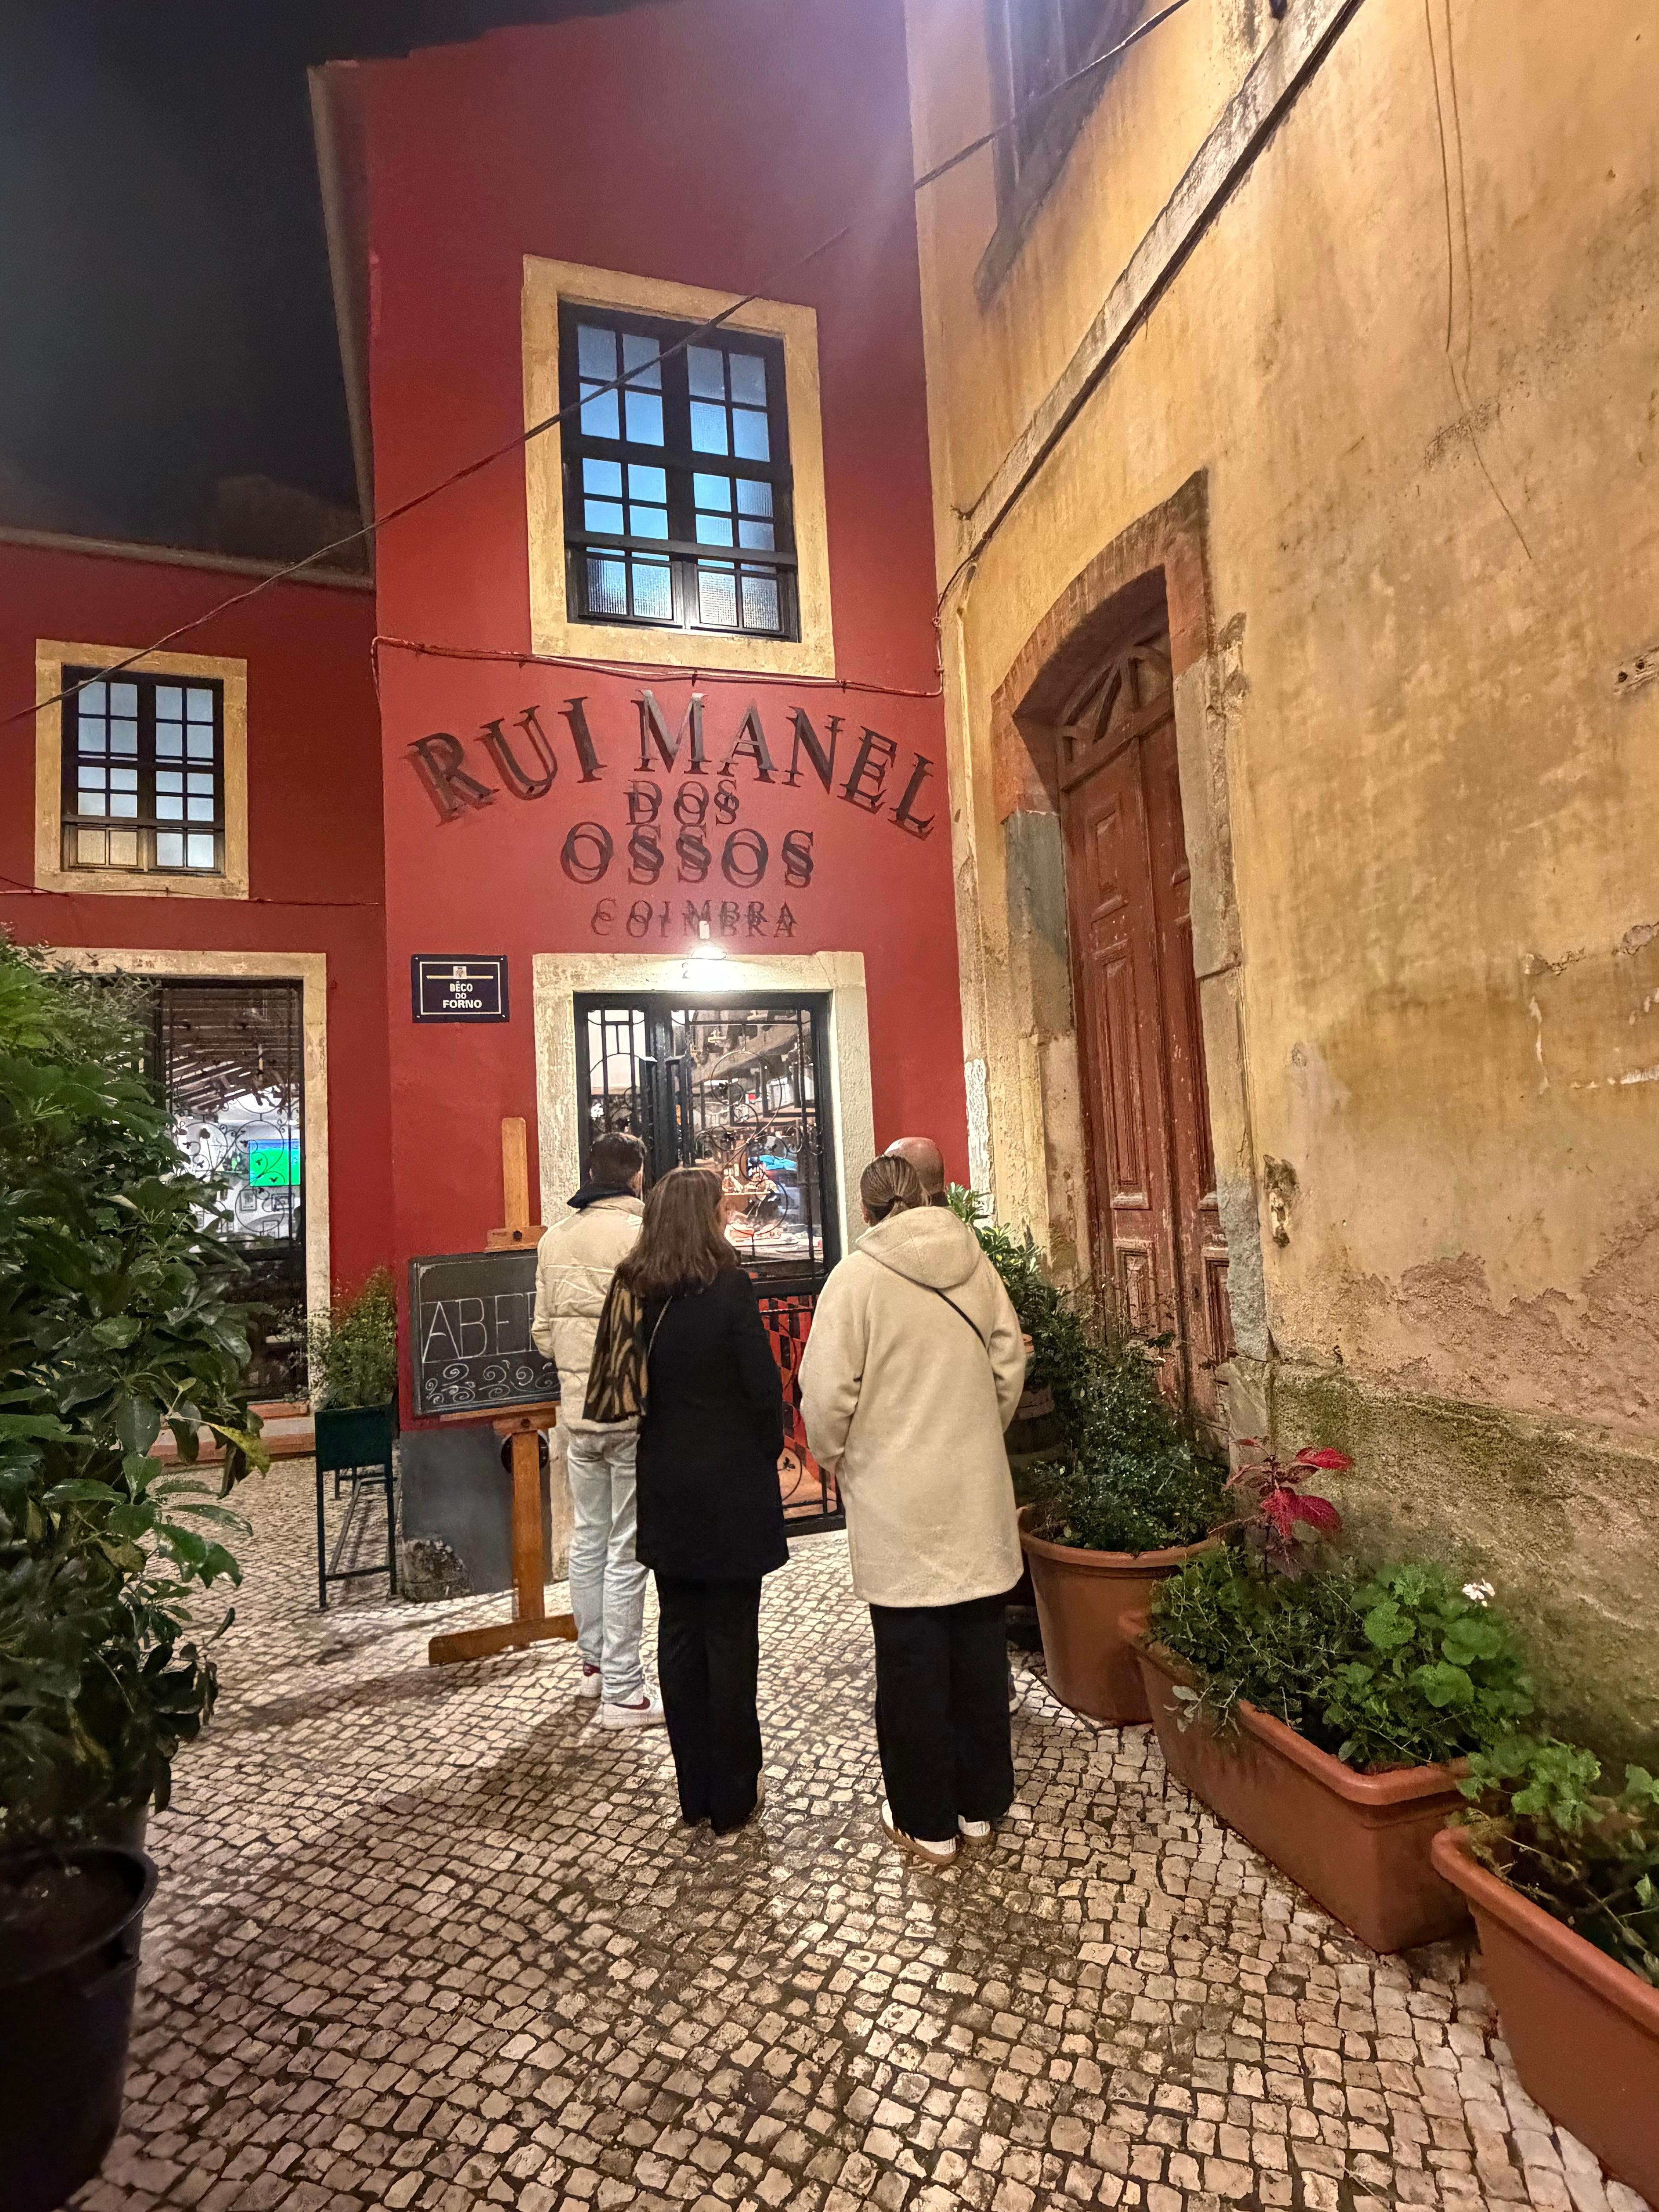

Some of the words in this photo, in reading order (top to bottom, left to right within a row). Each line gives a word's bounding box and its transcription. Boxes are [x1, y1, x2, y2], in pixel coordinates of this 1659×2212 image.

[400, 696, 609, 825] RUI
[630, 688, 936, 840] MANEL
[623, 779, 740, 826] DOS
[560, 821, 814, 888] OSSOS
[591, 898, 798, 936] COIMBRA
[442, 1000, 483, 1008] FORNO
